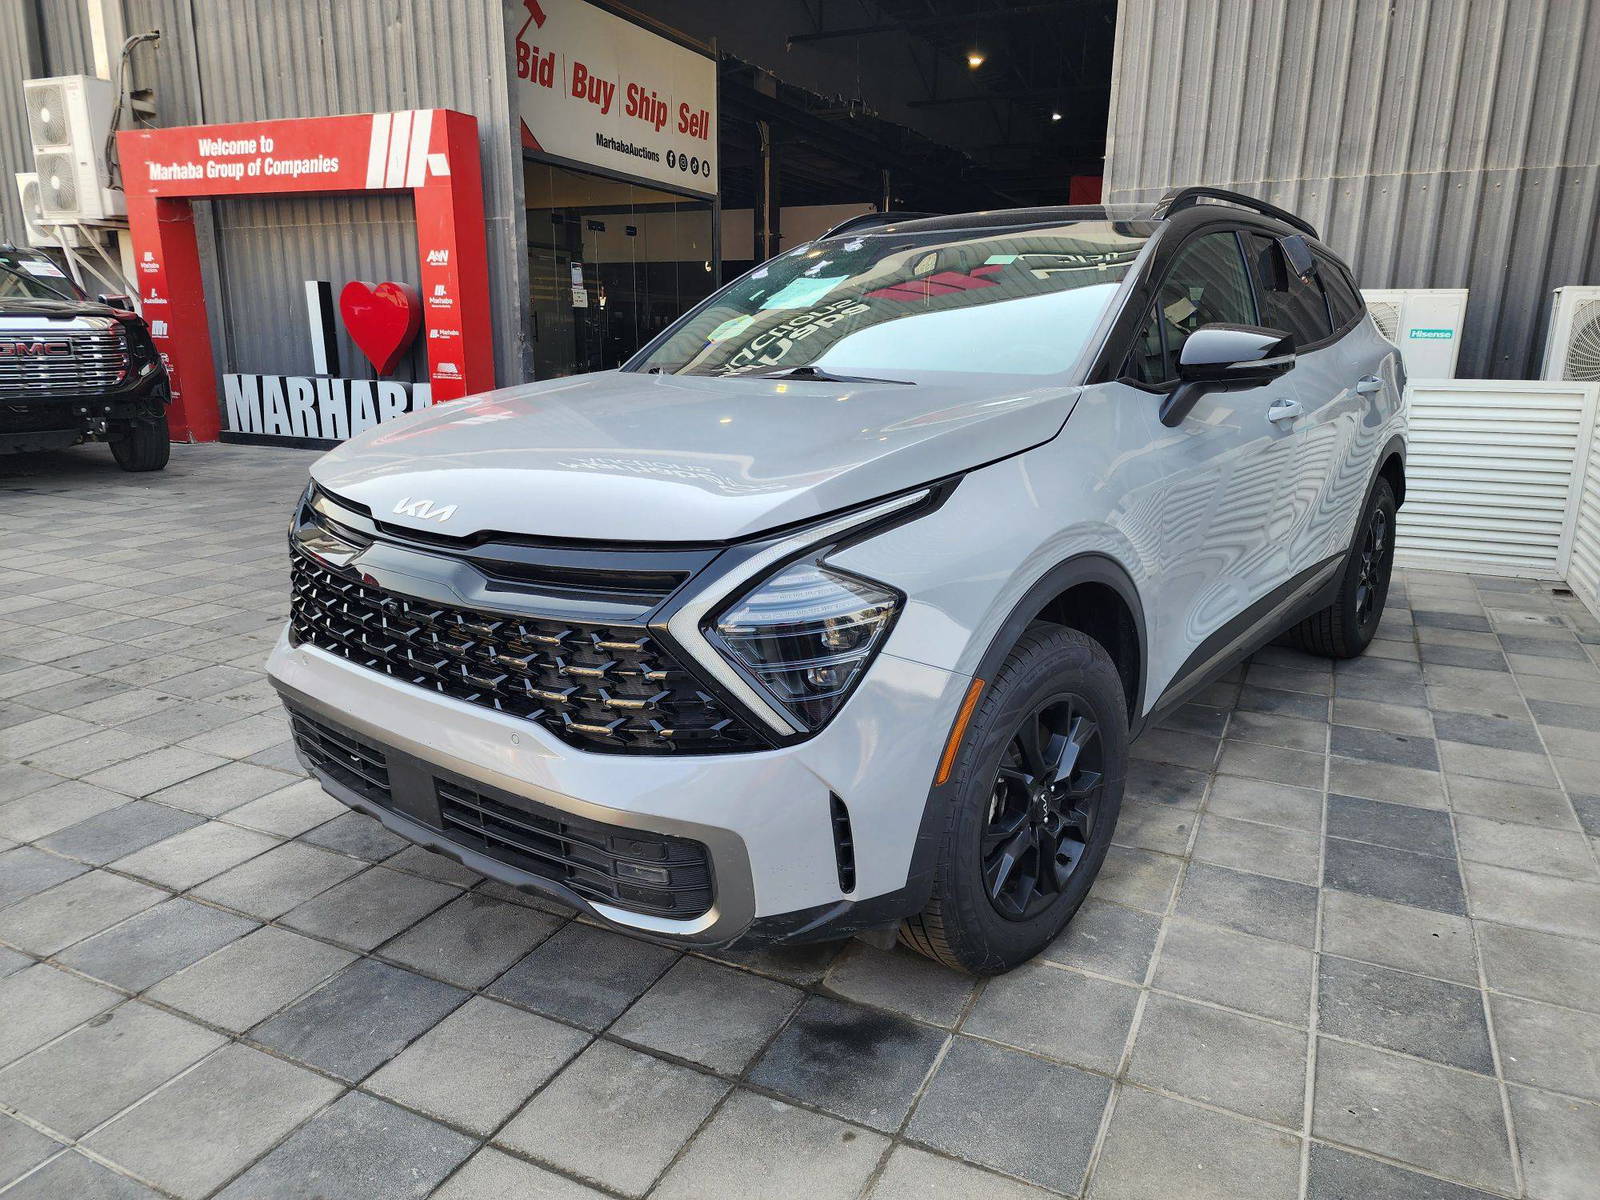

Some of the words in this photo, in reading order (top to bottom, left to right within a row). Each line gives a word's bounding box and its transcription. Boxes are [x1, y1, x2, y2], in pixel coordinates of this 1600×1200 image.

[516, 40, 555, 88] Bid
[572, 62, 615, 115] Buy
[625, 82, 668, 132] Ship
[678, 102, 710, 141] Sell
[198, 137, 257, 157] Welcome
[260, 135, 273, 153] to
[596, 132, 660, 163] MarhabaAuctions
[149, 161, 203, 180] Marhaba
[206, 159, 244, 181] Group
[248, 157, 262, 176] of
[264, 154, 340, 178] Companies
[1411, 329, 1452, 339] Hisense
[393, 496, 458, 523] KIA
